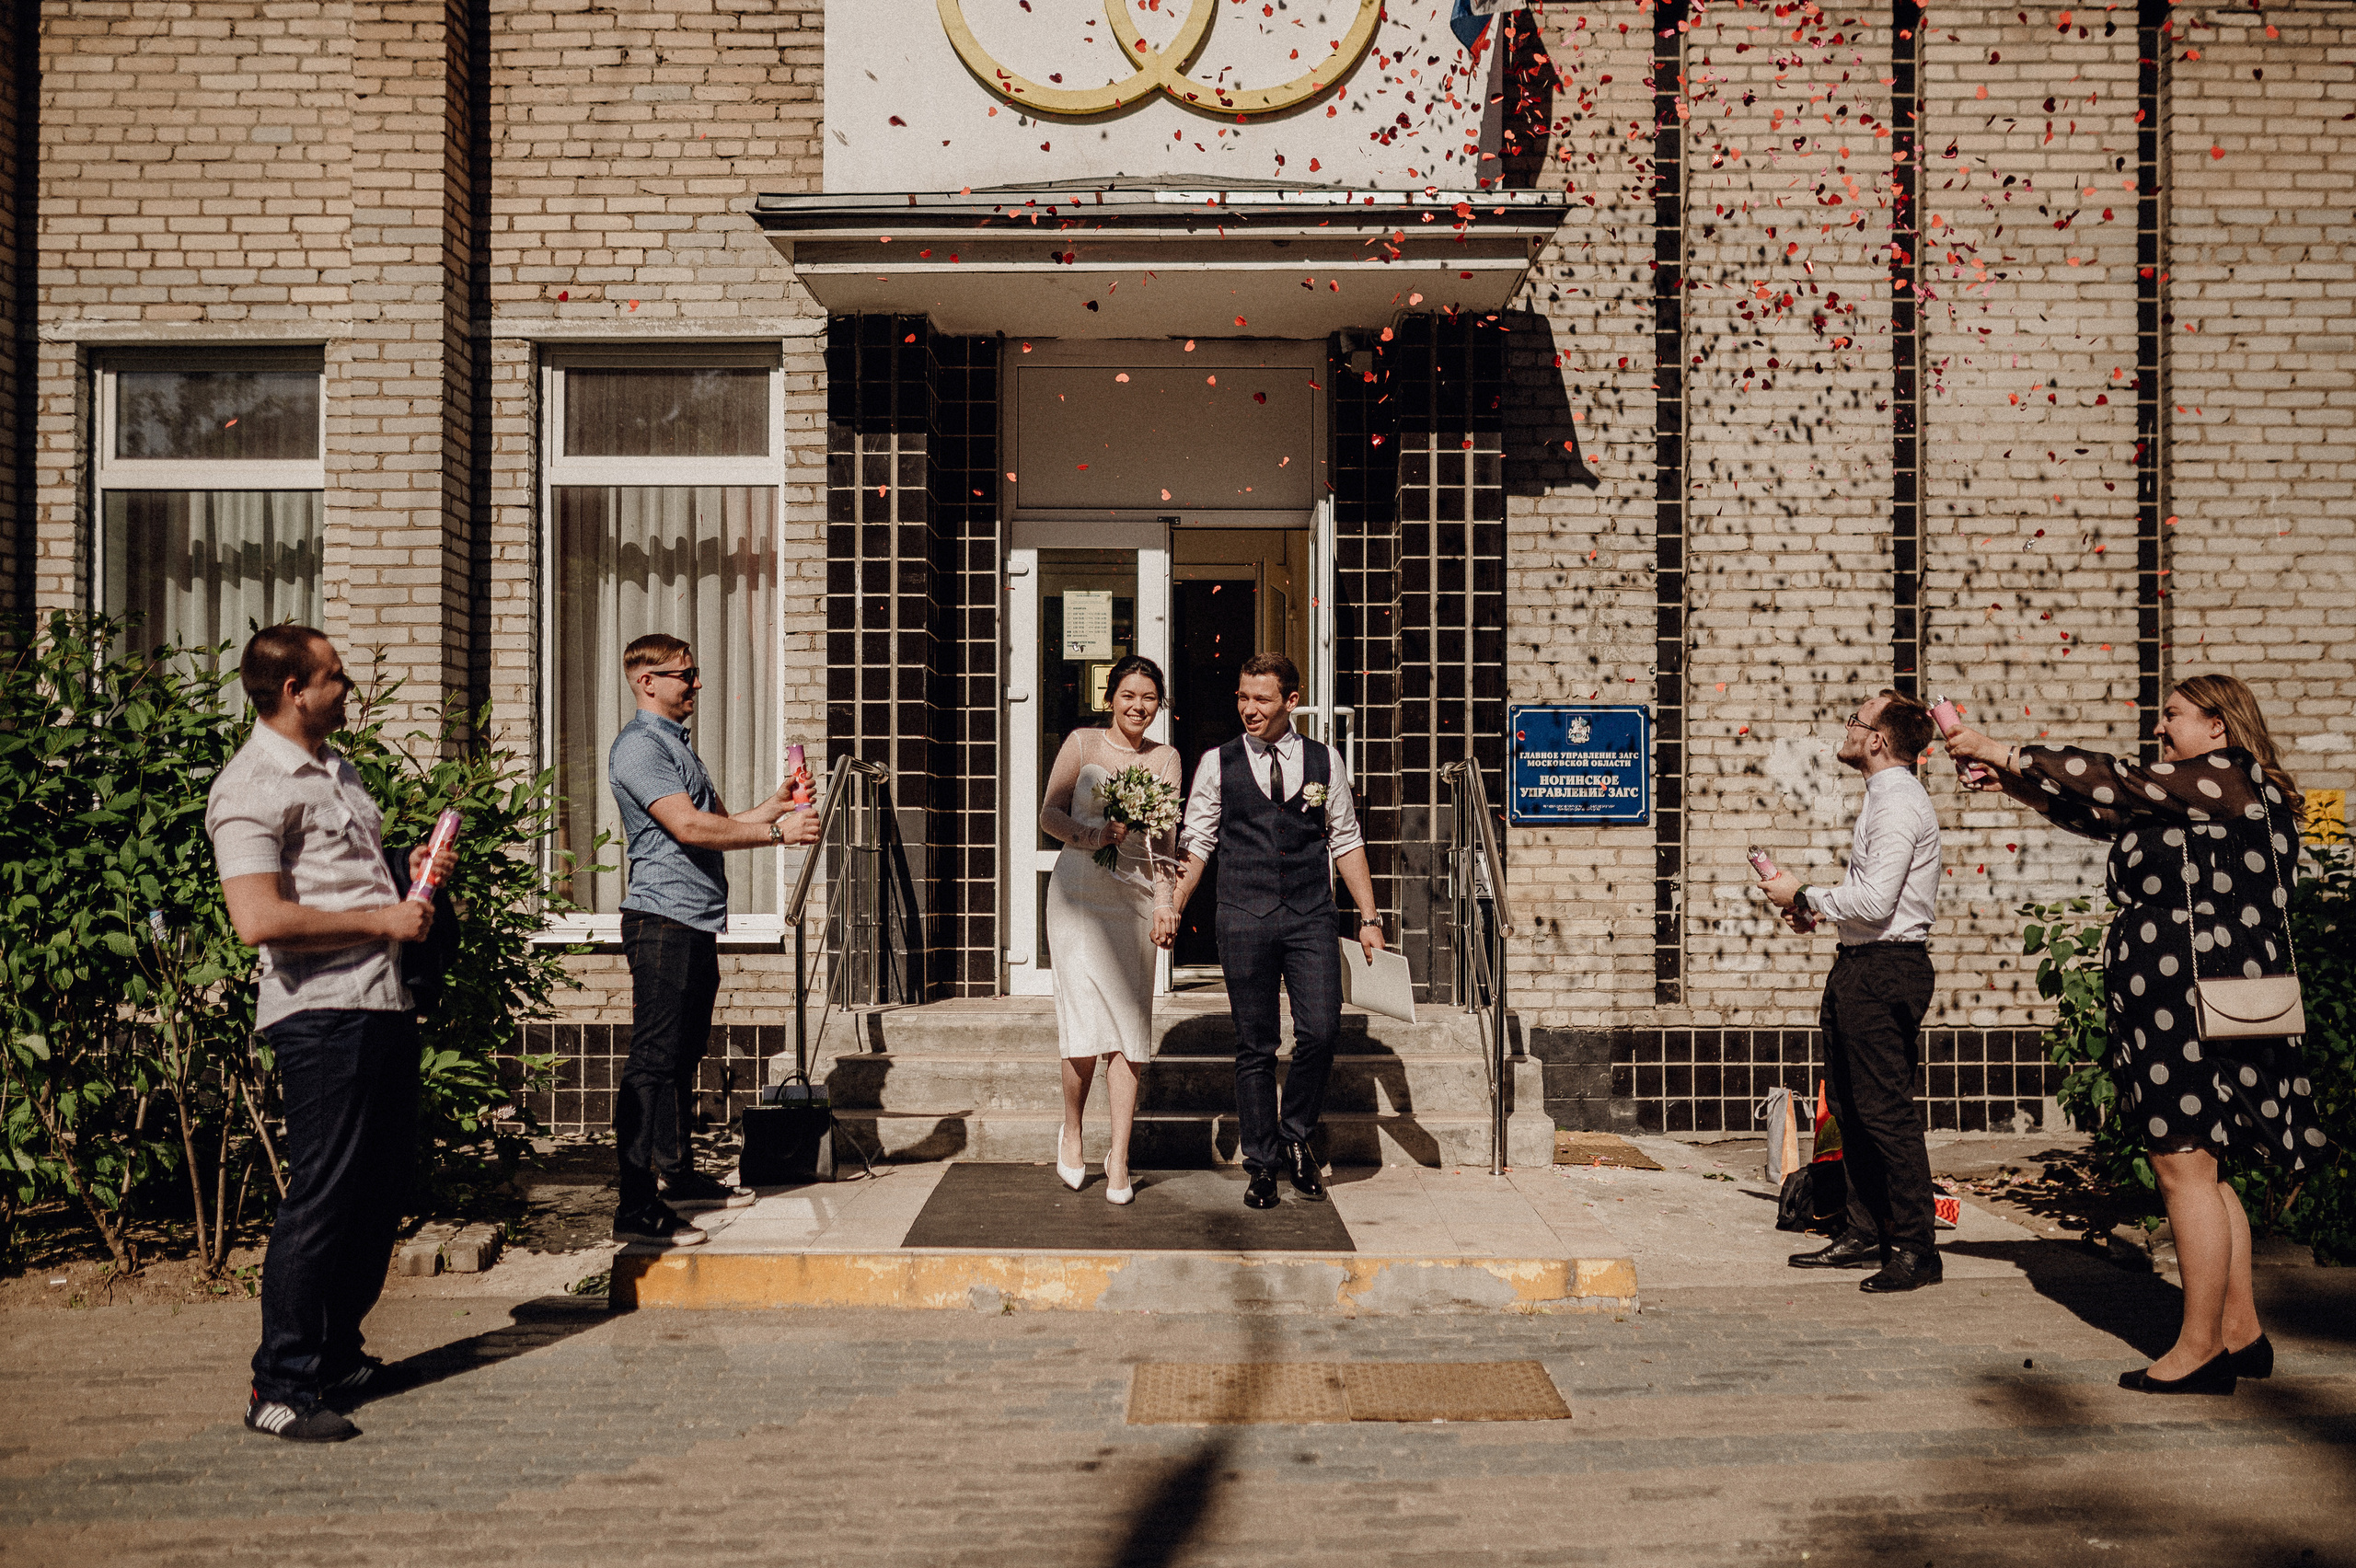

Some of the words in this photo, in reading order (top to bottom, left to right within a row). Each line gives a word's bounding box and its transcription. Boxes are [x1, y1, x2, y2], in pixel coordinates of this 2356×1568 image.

[1527, 759, 1589, 767] МОСКОВСКОЙ
[1590, 759, 1632, 767] ОБЛАСТИ
[1540, 775, 1619, 785] НОГИНСКОЕ
[1519, 787, 1606, 798] УПРАВЛЕНИЕ
[1608, 787, 1639, 798] ЗАГС
